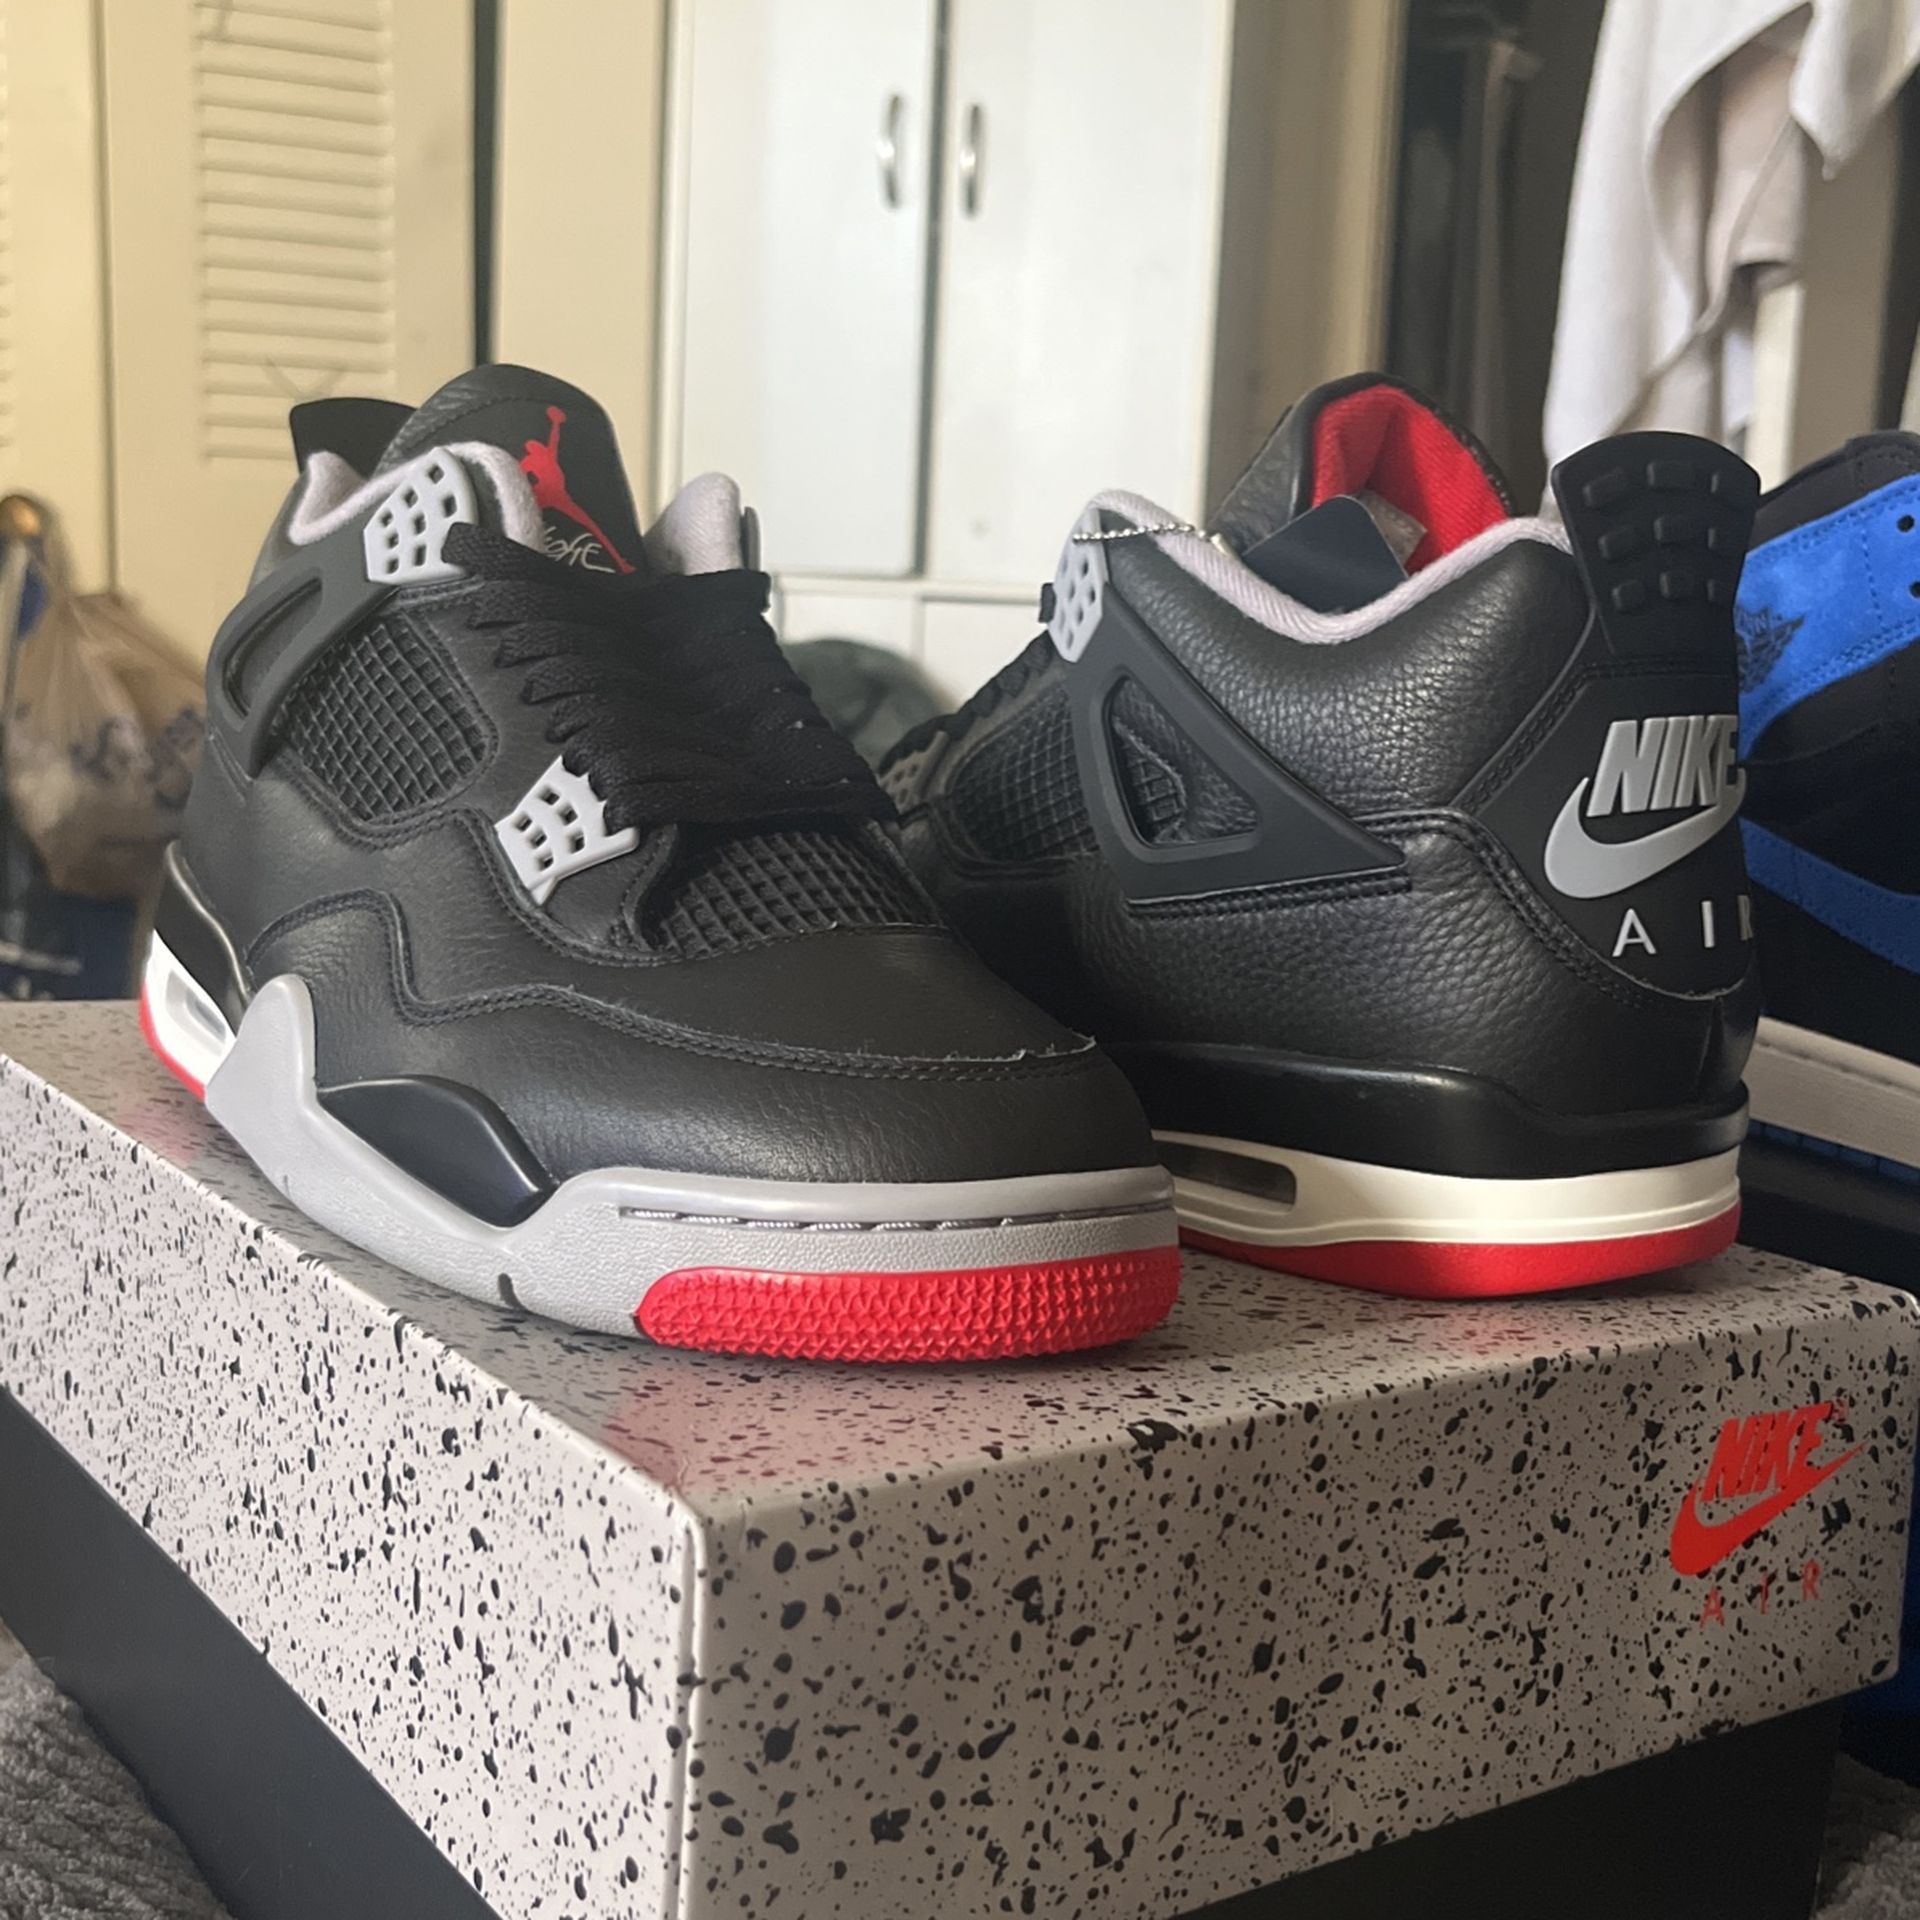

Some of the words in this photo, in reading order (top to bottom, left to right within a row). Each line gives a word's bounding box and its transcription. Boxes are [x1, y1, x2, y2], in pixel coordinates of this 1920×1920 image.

[1586, 714, 1739, 817] NIKE
[1701, 1401, 1834, 1503] NIKE
[1699, 1558, 1821, 1628] AIR
